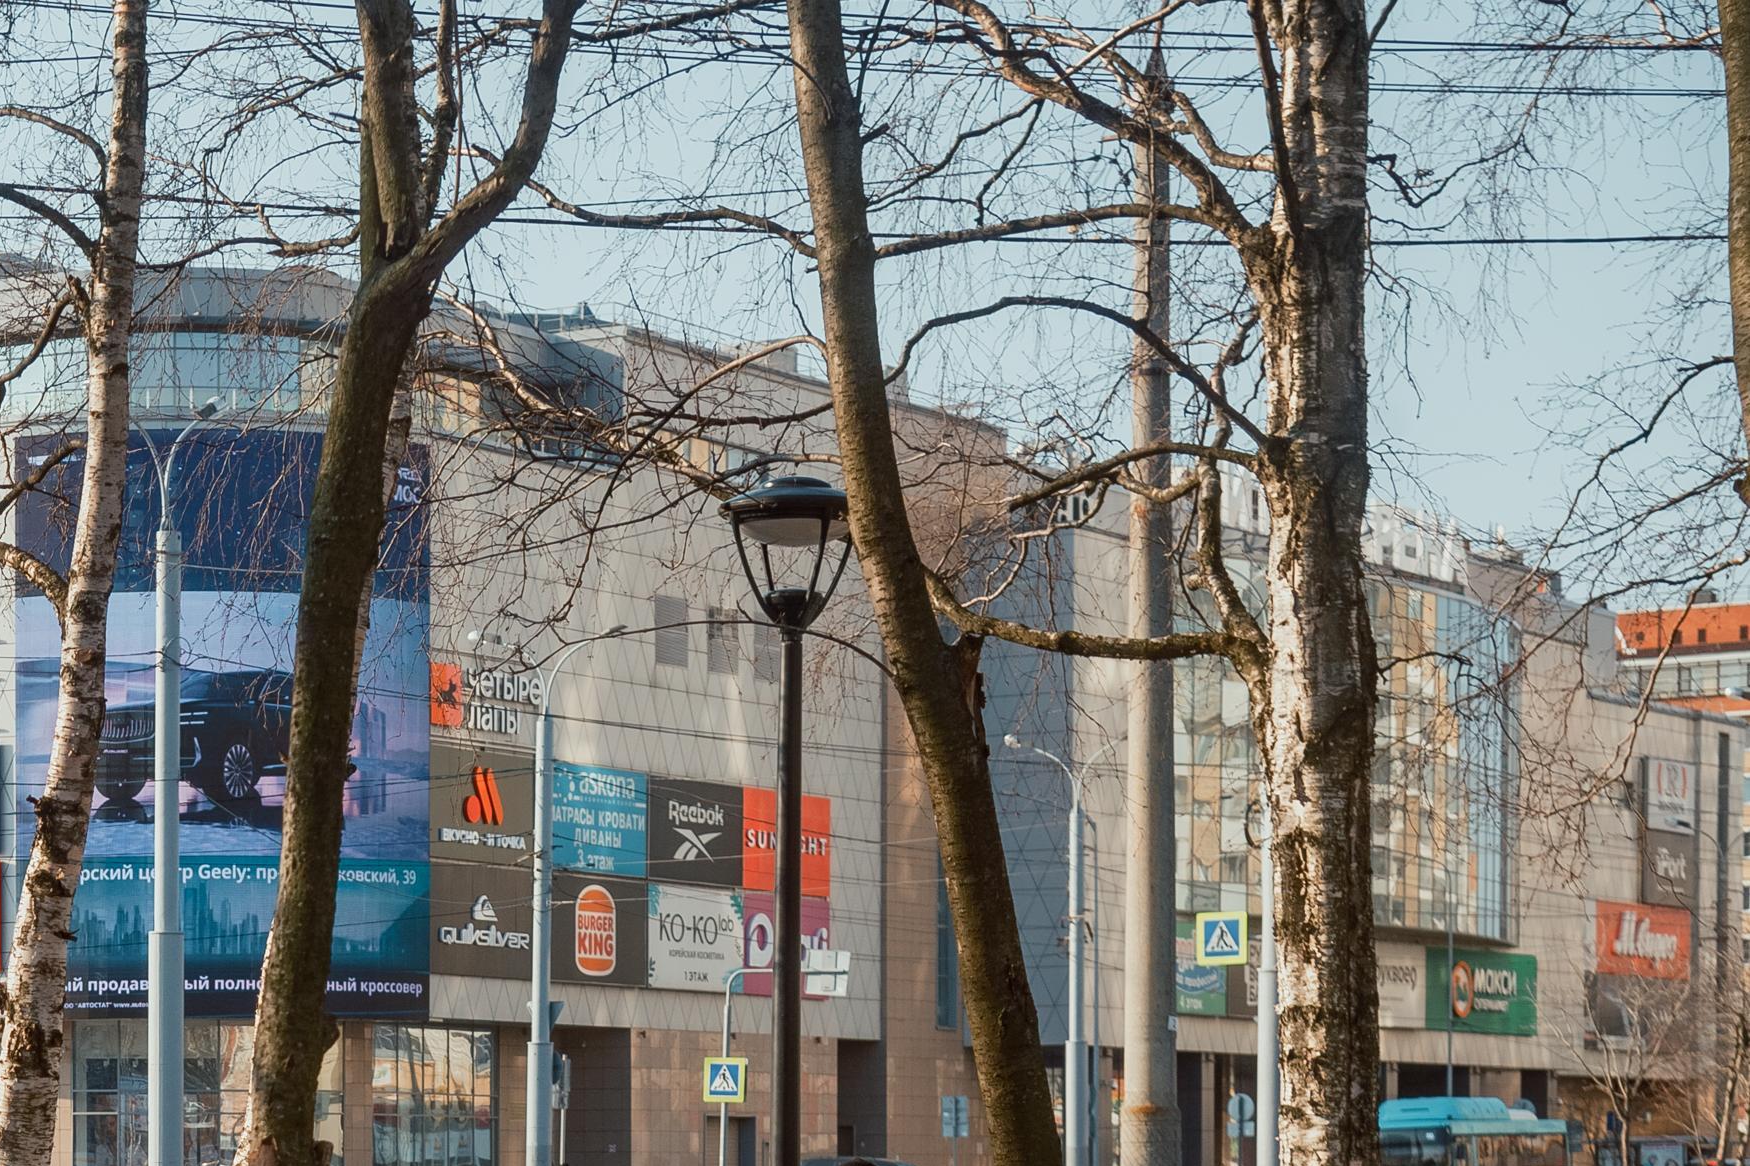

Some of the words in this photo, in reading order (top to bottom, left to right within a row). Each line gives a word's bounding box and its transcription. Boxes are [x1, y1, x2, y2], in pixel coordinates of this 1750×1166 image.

[598, 811, 645, 832] КРОВАТИ
[668, 800, 725, 826] Reebok
[574, 832, 622, 849] ДИВАНЫ
[198, 864, 251, 883] Geely:
[403, 870, 417, 884] 39
[577, 913, 614, 932] BURGER
[577, 932, 614, 957] KING
[361, 981, 423, 998] кроссовер
